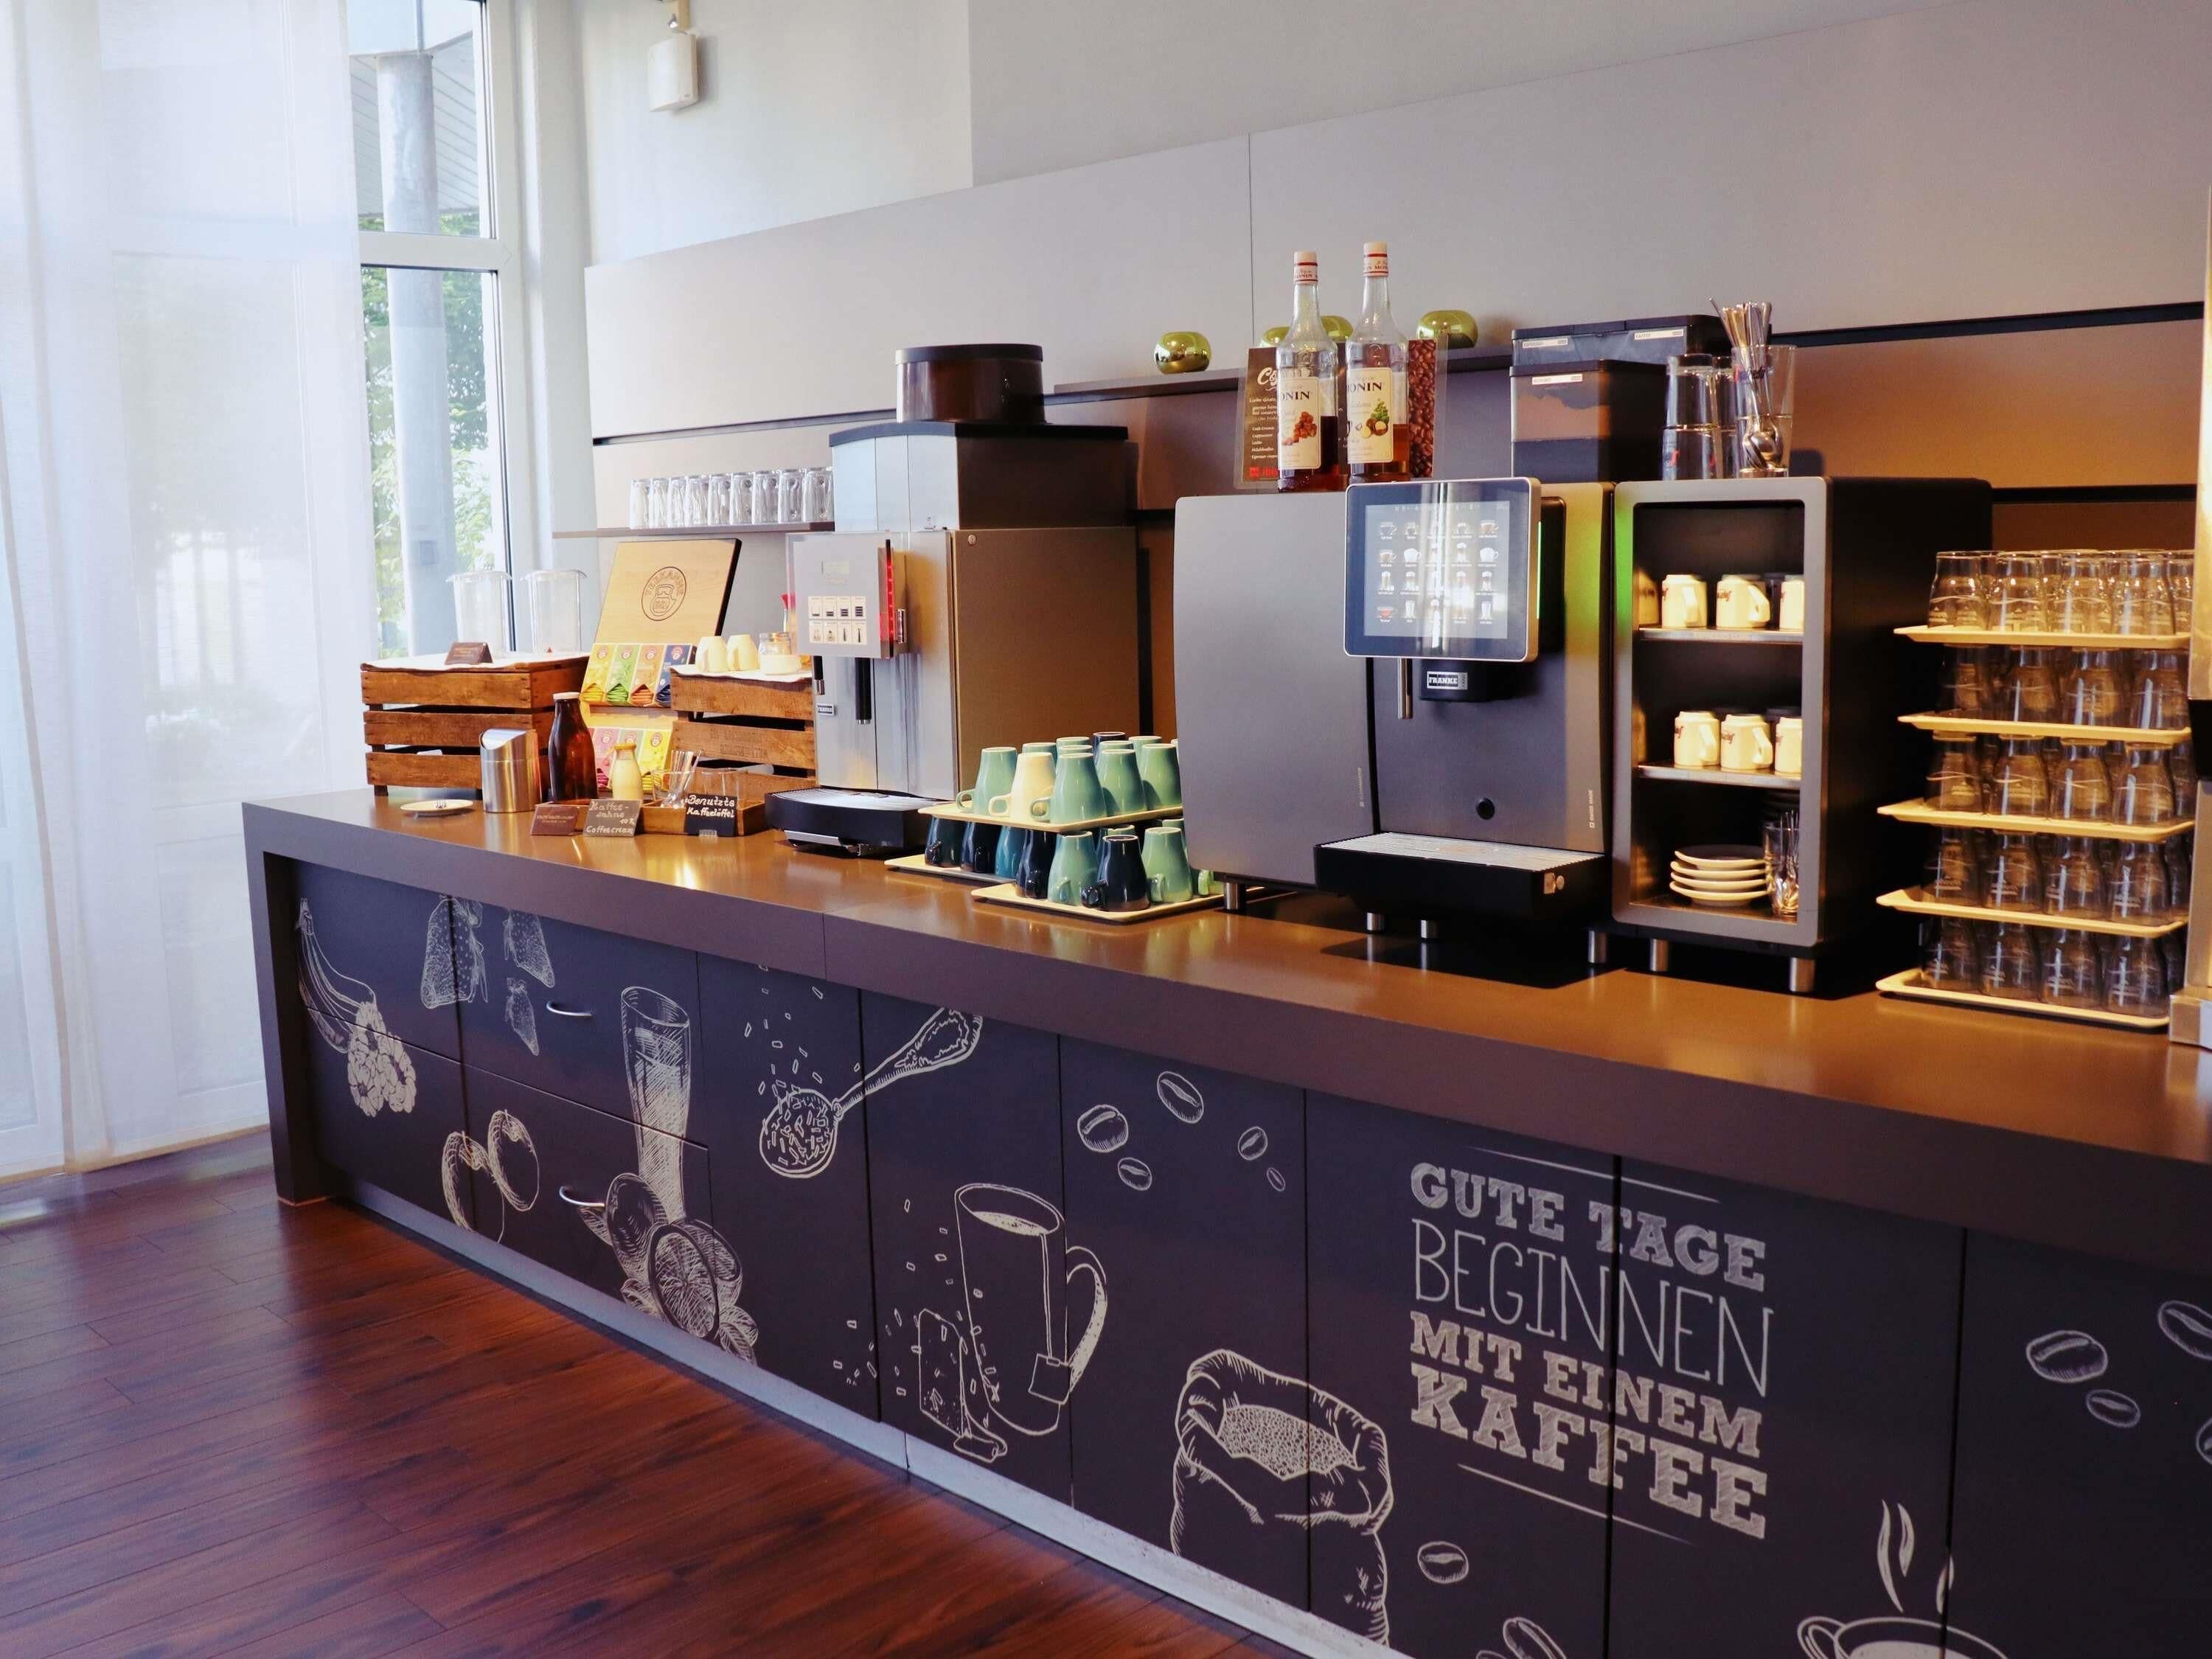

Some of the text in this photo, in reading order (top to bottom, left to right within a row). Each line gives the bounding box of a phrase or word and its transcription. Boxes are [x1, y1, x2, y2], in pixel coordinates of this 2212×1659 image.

[687, 795, 735, 807] Benutzte
[1410, 1163, 1766, 1292] GUTE TAGE
[1411, 1218, 1774, 1397] BEGINNEN
[1410, 1311, 1762, 1458] MIT EINEM
[1410, 1362, 1767, 1540] KAFFEE
